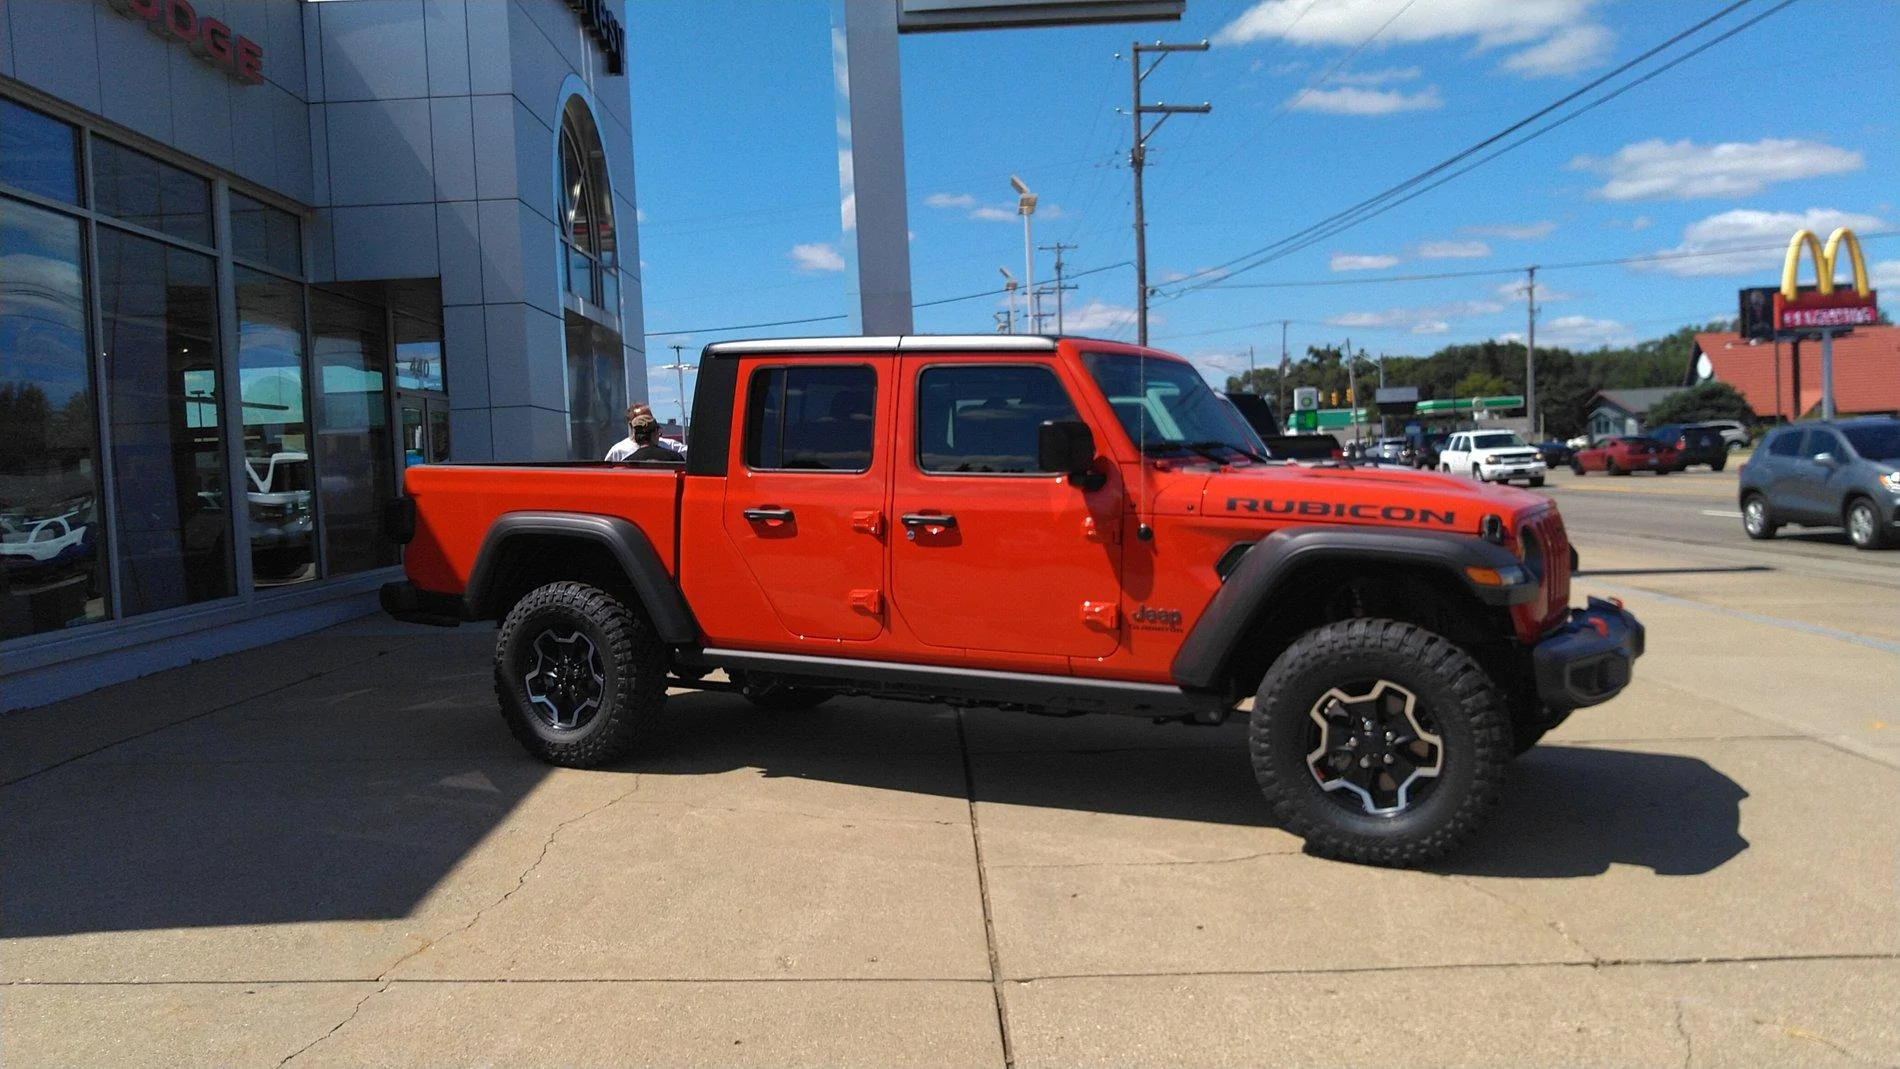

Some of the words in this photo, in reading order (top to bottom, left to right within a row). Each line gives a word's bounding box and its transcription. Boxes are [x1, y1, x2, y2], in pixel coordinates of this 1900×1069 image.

[410, 357, 430, 379] 440
[1226, 497, 1455, 525] RUBICON
[1132, 605, 1182, 629] Jeep
